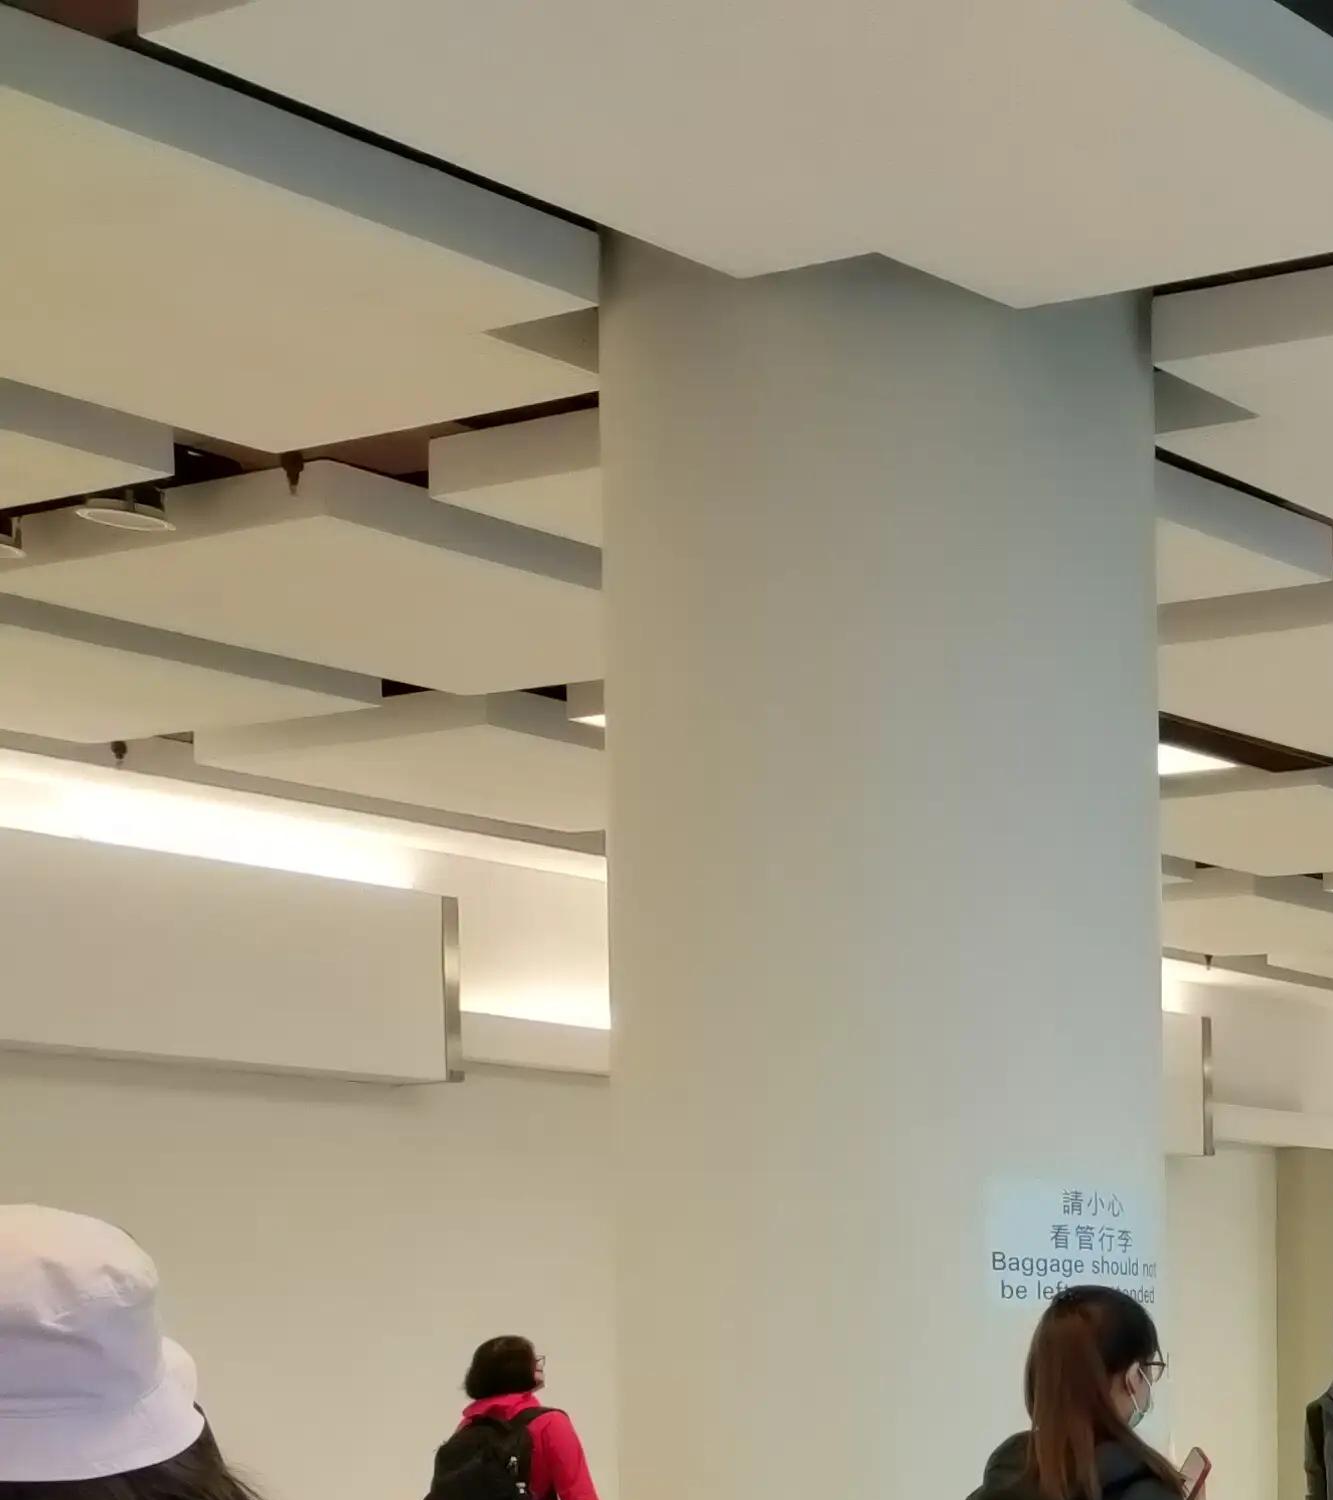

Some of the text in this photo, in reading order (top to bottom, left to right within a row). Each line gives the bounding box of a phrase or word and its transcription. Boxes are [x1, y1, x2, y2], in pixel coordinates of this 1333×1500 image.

[1063, 1190, 1124, 1217] 請小心
[1050, 1224, 1133, 1254] 看管行李
[991, 1251, 1157, 1278] Baggage should not
[1001, 1279, 1028, 1300] be
[1037, 1279, 1068, 1301] lef
